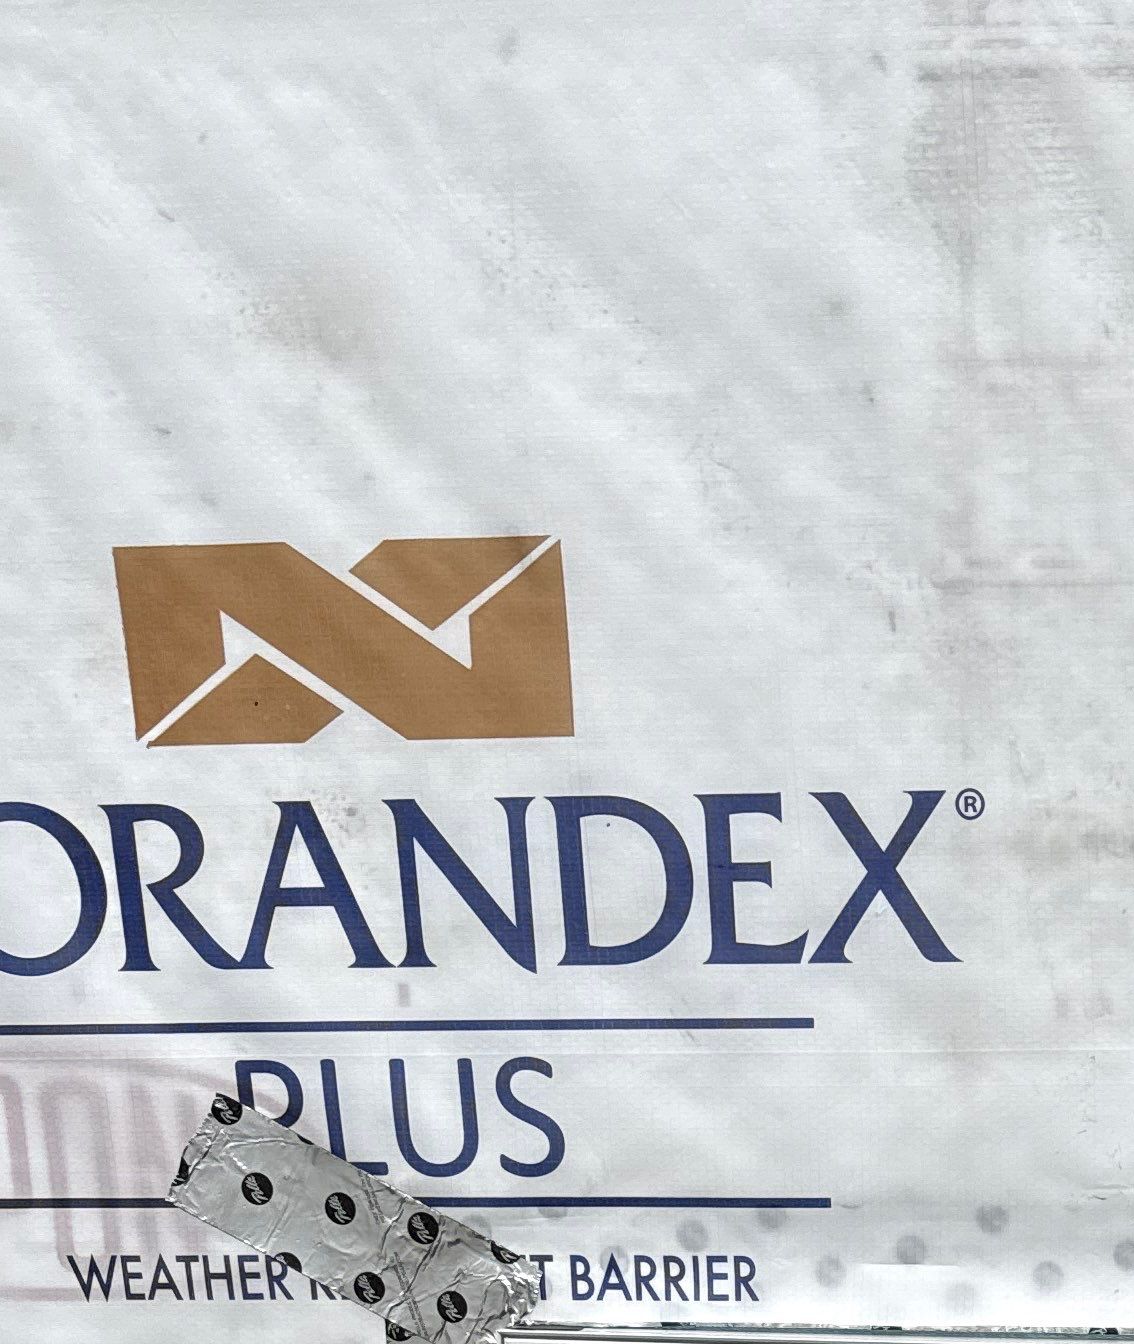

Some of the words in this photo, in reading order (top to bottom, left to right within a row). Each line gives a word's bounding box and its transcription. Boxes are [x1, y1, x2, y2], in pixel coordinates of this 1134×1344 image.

[235, 1056, 566, 1178] PLUS
[66, 1252, 295, 1303] WEATHER
[568, 1254, 761, 1302] BARRIER
